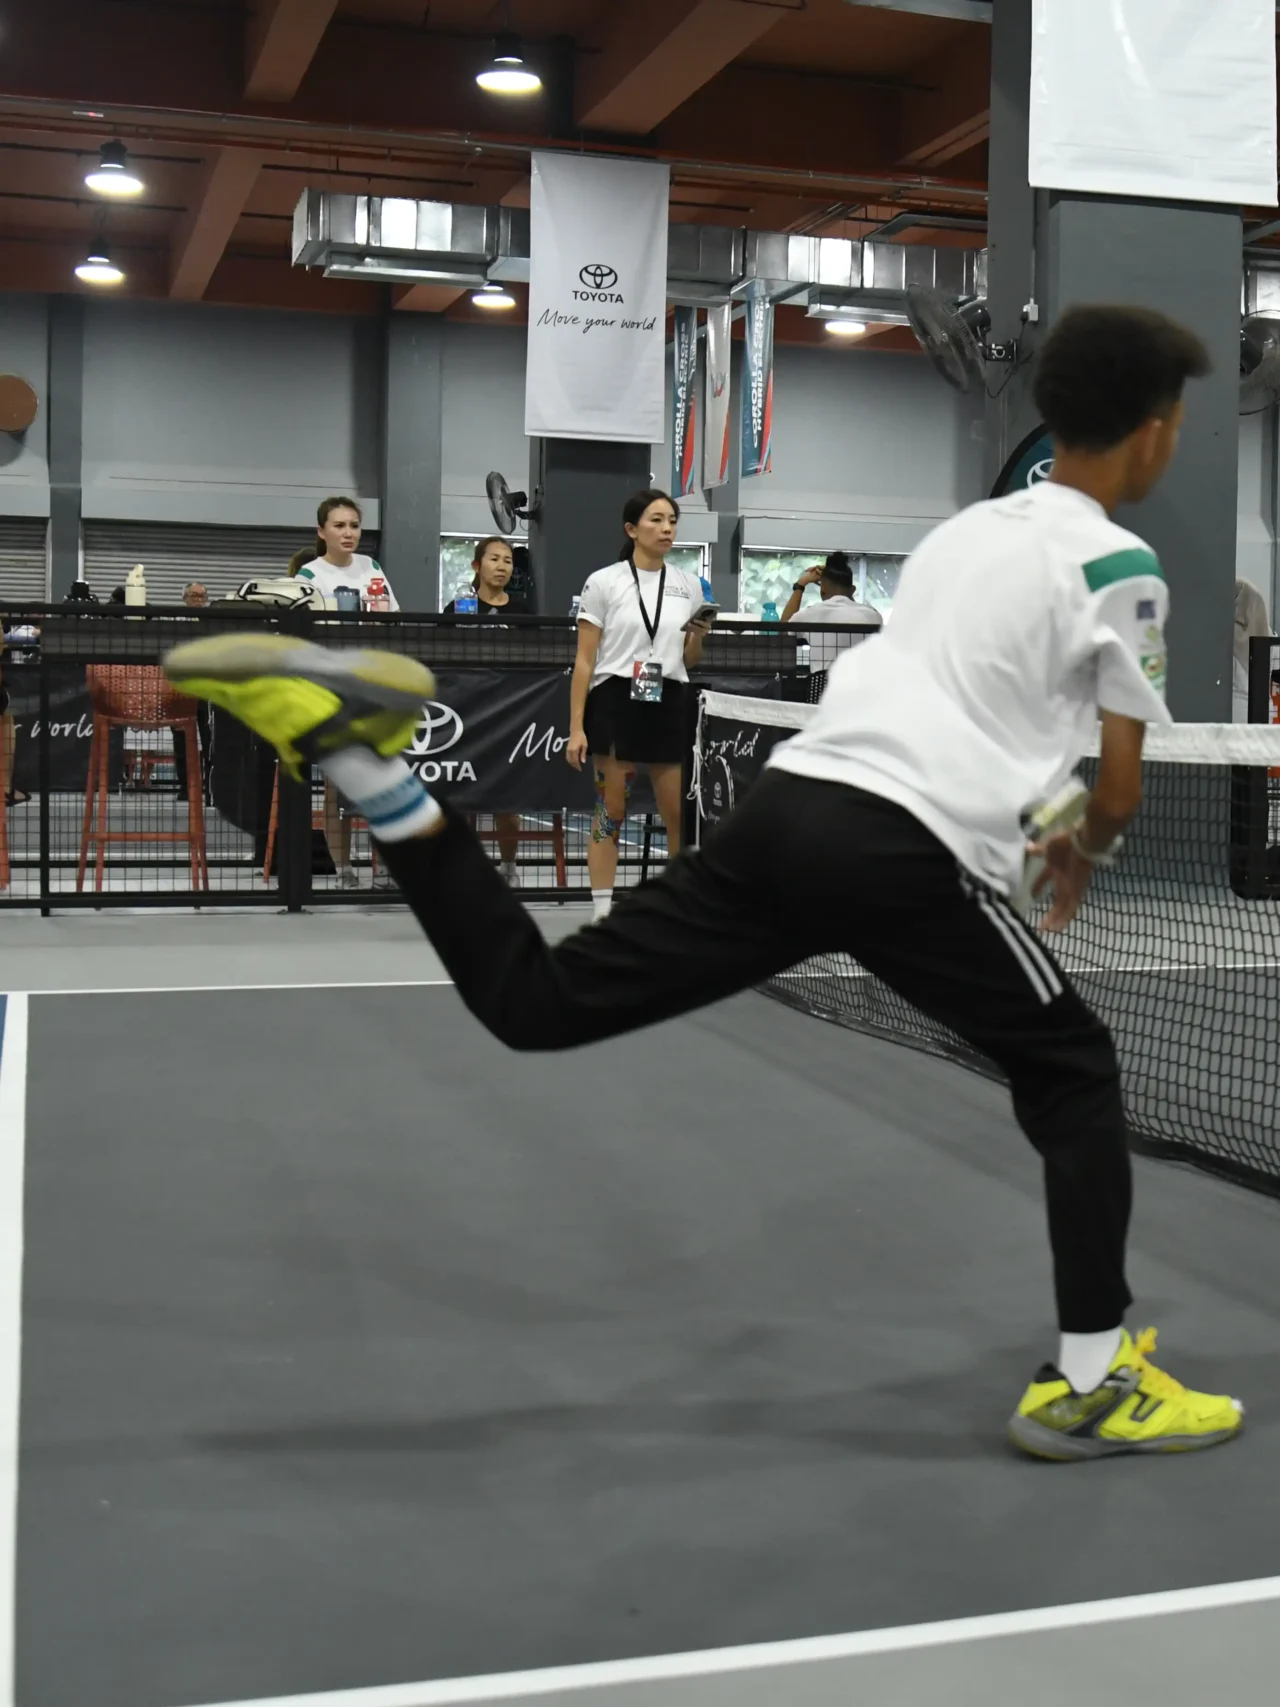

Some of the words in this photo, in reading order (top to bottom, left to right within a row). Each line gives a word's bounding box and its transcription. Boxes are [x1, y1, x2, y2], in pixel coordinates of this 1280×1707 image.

[536, 308, 581, 327] Move
[582, 317, 617, 334] your
[620, 316, 657, 331] world
[572, 290, 624, 304] TOYOTA
[751, 352, 759, 449] COROLLA
[675, 386, 686, 473] COROLLA
